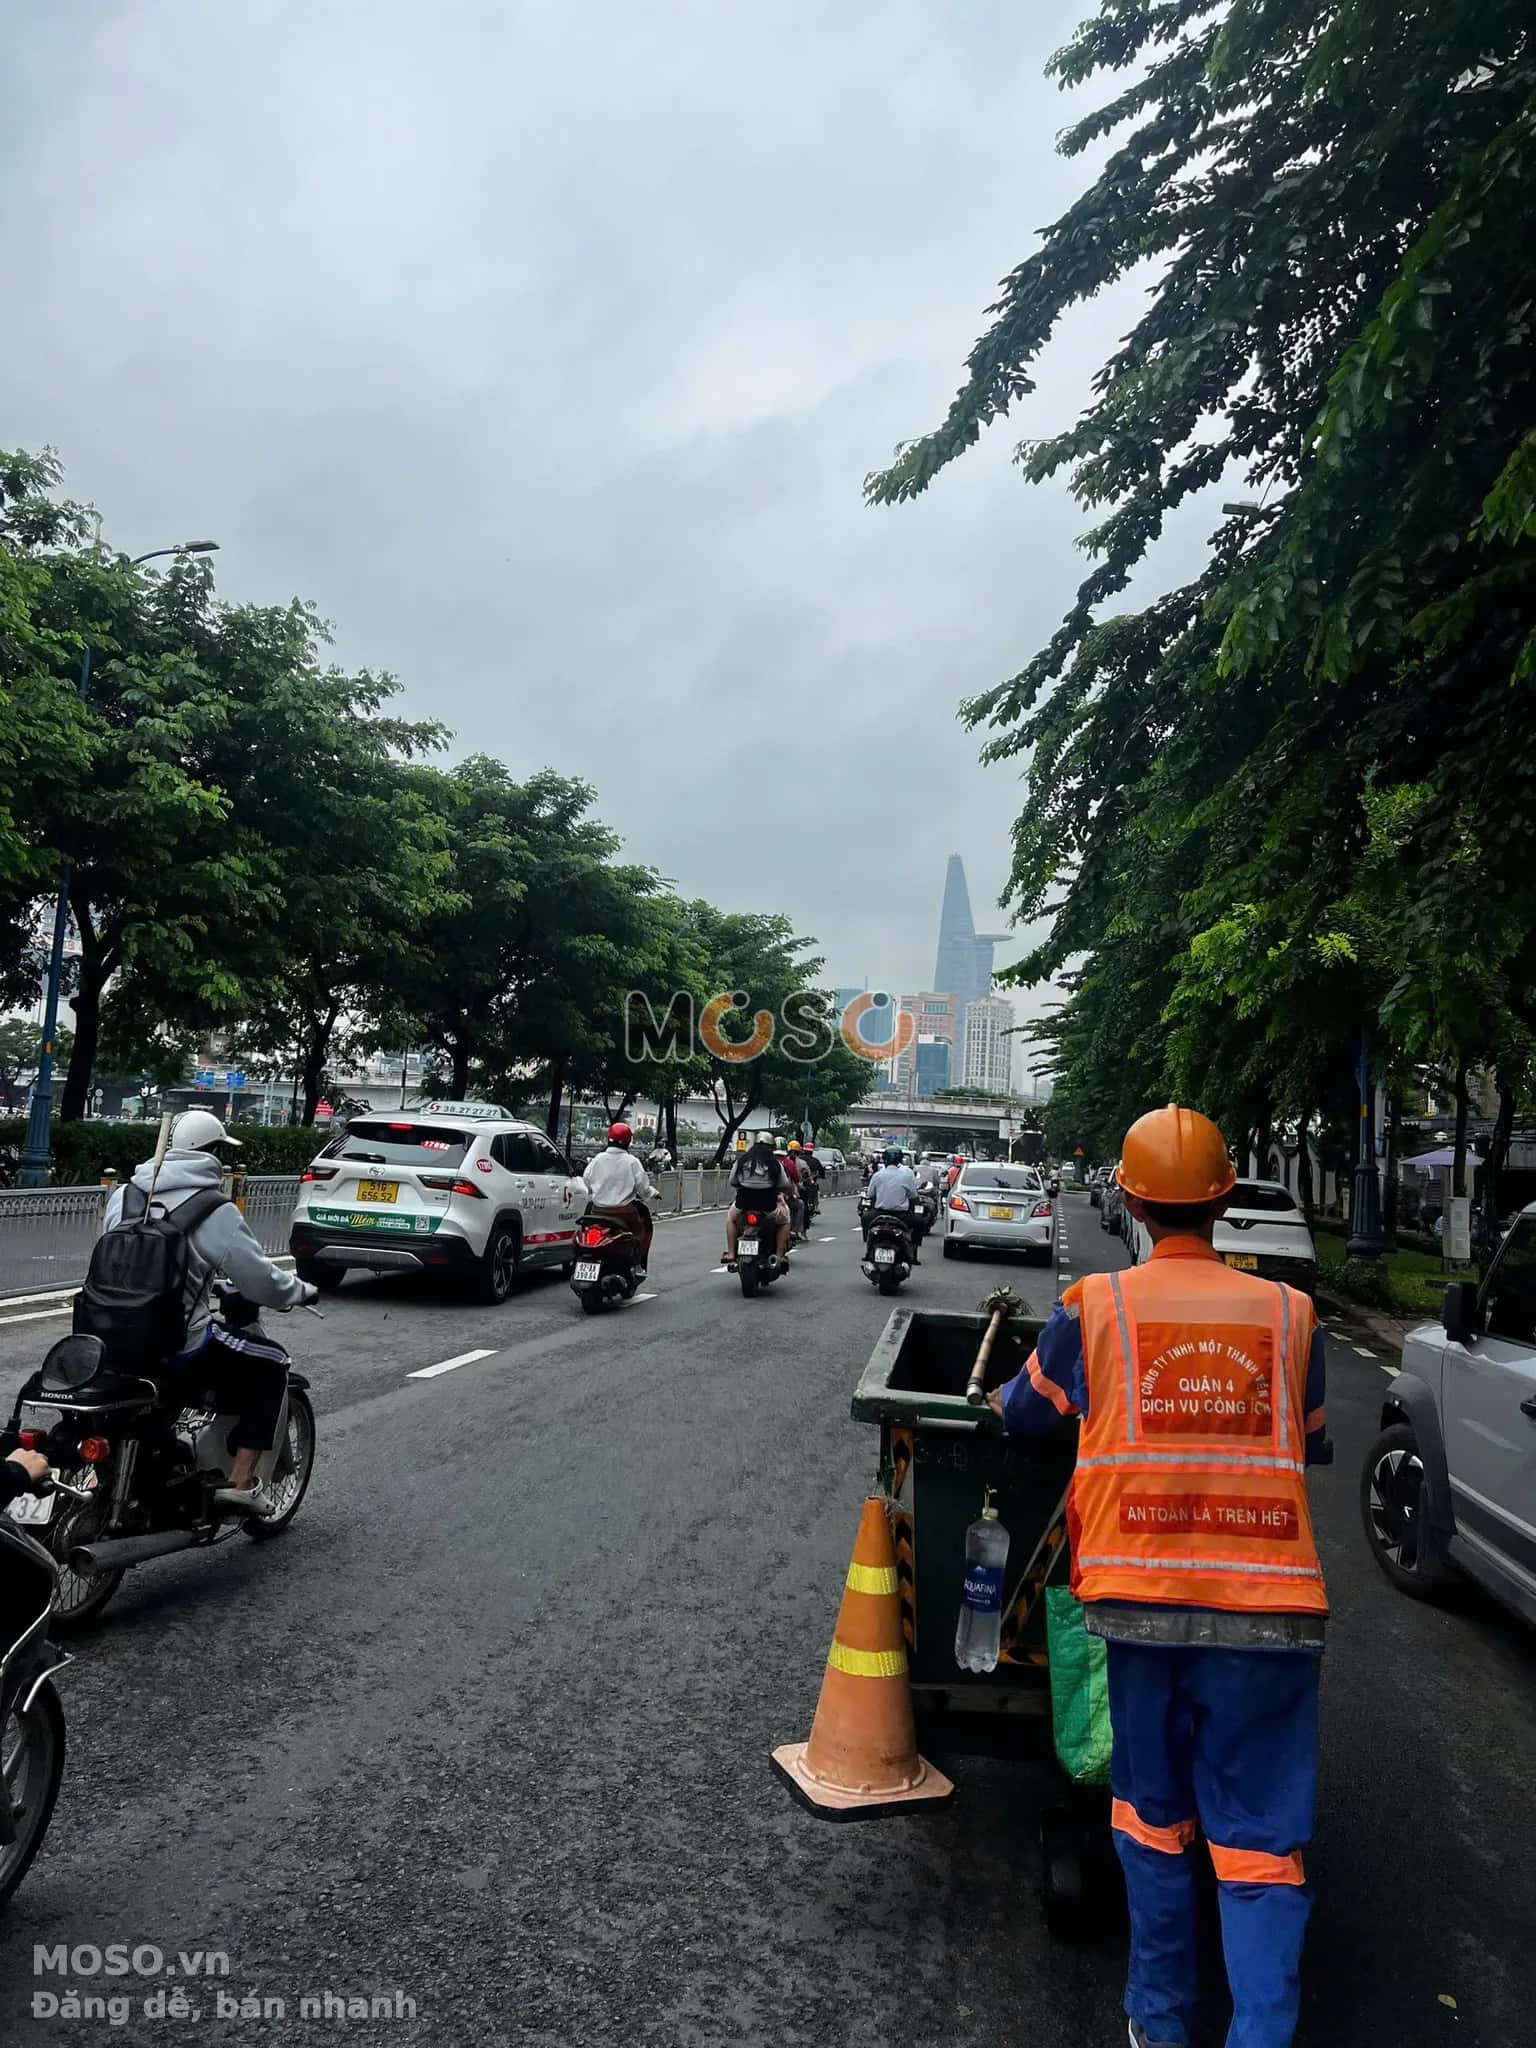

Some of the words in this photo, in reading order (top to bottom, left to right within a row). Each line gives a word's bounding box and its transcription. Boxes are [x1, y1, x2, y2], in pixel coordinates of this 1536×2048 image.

[1153, 1355, 1168, 1369] TY
[1165, 1342, 1195, 1360] TNHH
[1199, 1339, 1222, 1355] MỘT
[1179, 1375, 1221, 1395] QUẬN
[1226, 1380, 1235, 1393] 4
[41, 1391, 73, 1400] HONDA
[1141, 1399, 1175, 1415] DỊCH
[1179, 1399, 1199, 1416] VỤ
[1204, 1396, 1246, 1415] CÔNG
[1127, 1506, 1145, 1520] AN
[1148, 1502, 1188, 1521] TOÀN
[1192, 1502, 1211, 1521] LÀ
[1216, 1504, 1256, 1524] TRÊN
[1261, 1504, 1289, 1526] HẾT
